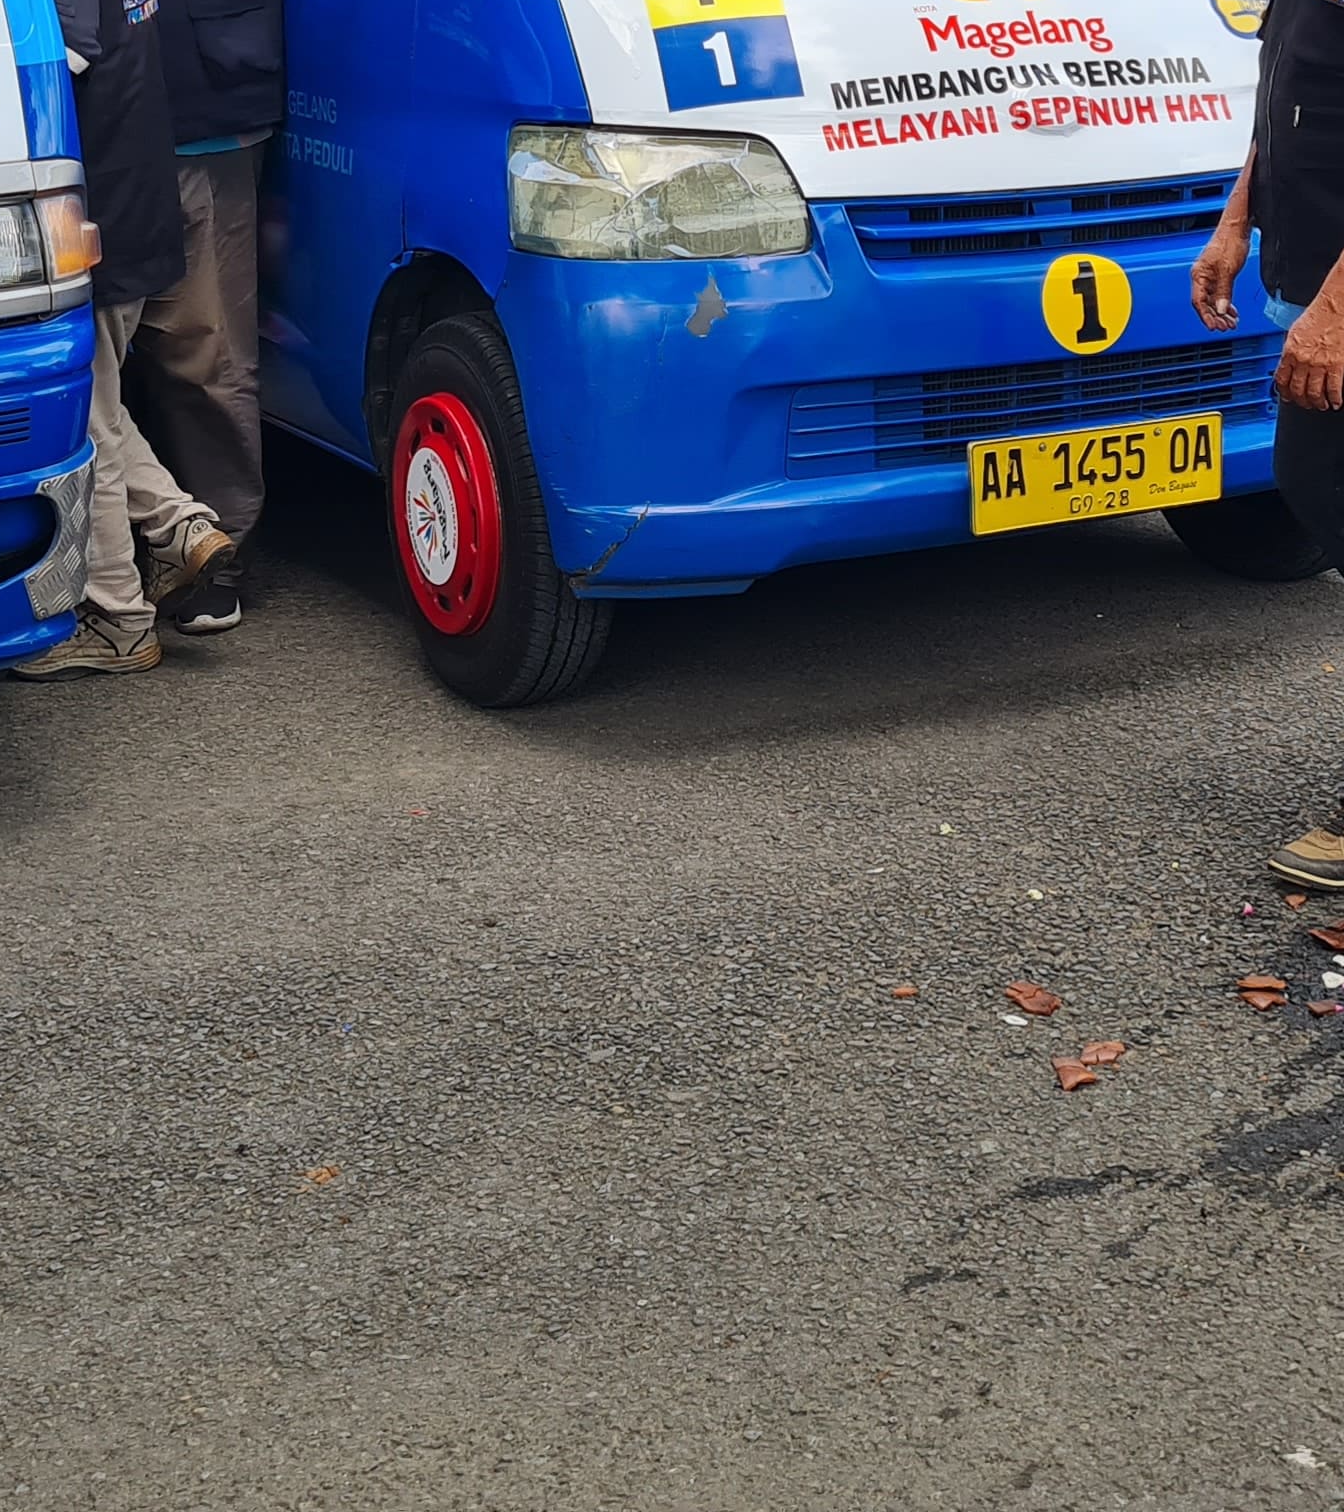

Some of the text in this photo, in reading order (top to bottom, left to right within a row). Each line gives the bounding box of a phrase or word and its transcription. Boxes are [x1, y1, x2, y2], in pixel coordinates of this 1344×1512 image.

[913, 4, 938, 15] KOTA
[918, 10, 1114, 58] Magelang
[702, 31, 737, 87] 1
[829, 56, 1211, 111] MEMBANGUN BERSAMA
[287, 89, 337, 125] GELANG
[821, 93, 1233, 152] MELAYANI SEPENUH HATI
[304, 136, 354, 176] PEDULI
[1071, 260, 1109, 344] 1
[981, 447, 1027, 502] AA
[1052, 433, 1146, 492] 1455
